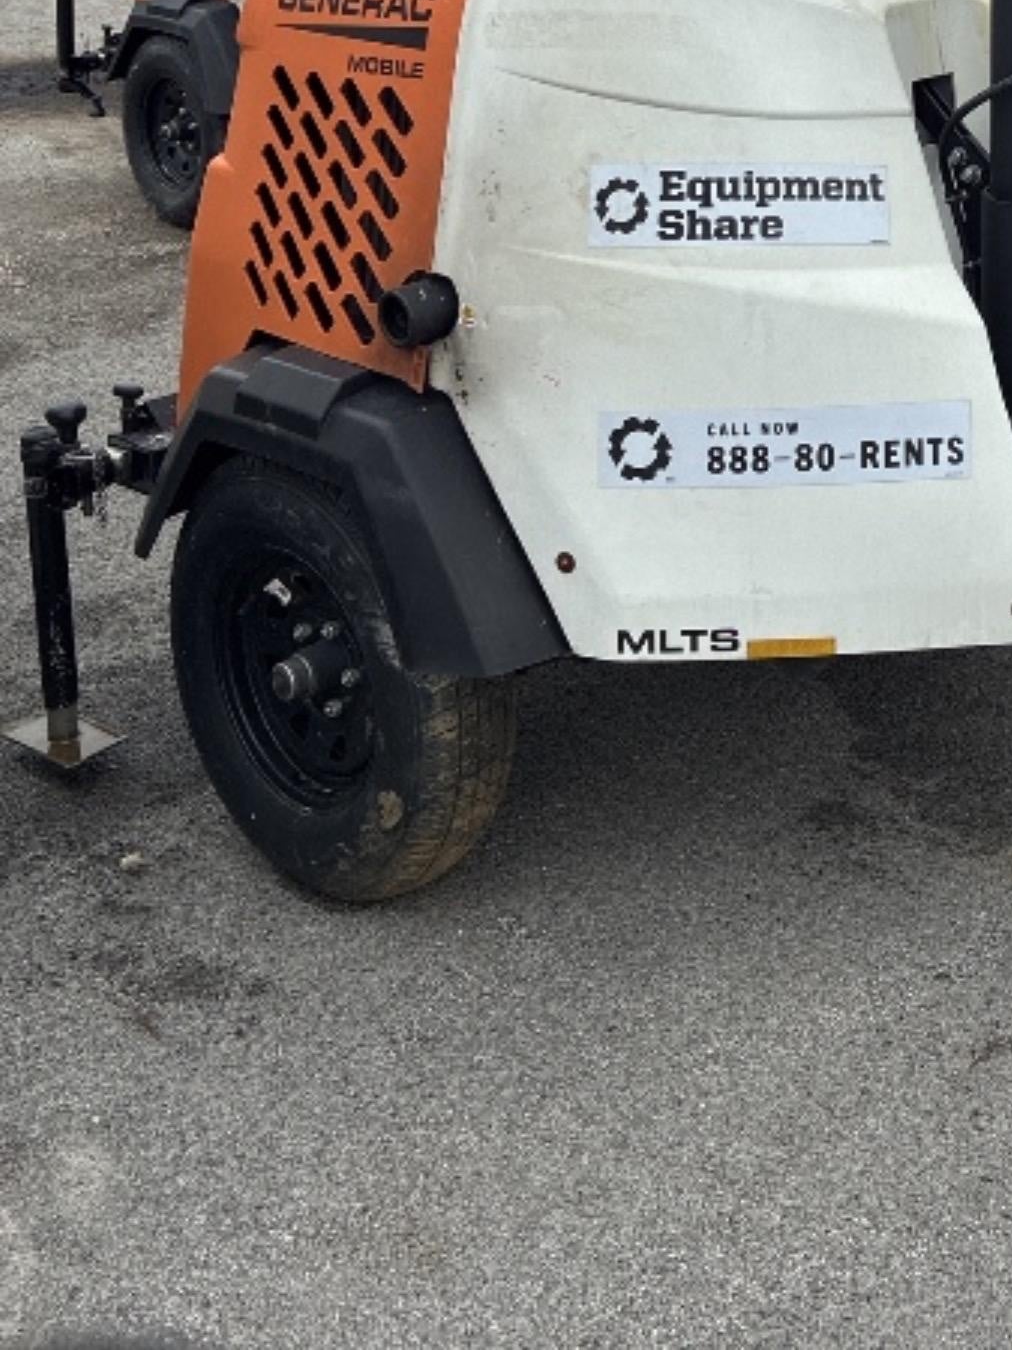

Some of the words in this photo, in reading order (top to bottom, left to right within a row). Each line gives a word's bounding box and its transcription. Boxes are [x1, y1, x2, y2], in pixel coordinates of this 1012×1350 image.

[347, 54, 425, 79] MOBILE
[658, 170, 886, 208] Equipment
[657, 209, 784, 241] Share
[707, 422, 751, 436] CALL
[761, 421, 799, 435] NOW
[707, 436, 965, 474] 888-80-RENTS
[617, 629, 740, 654] MLTS
